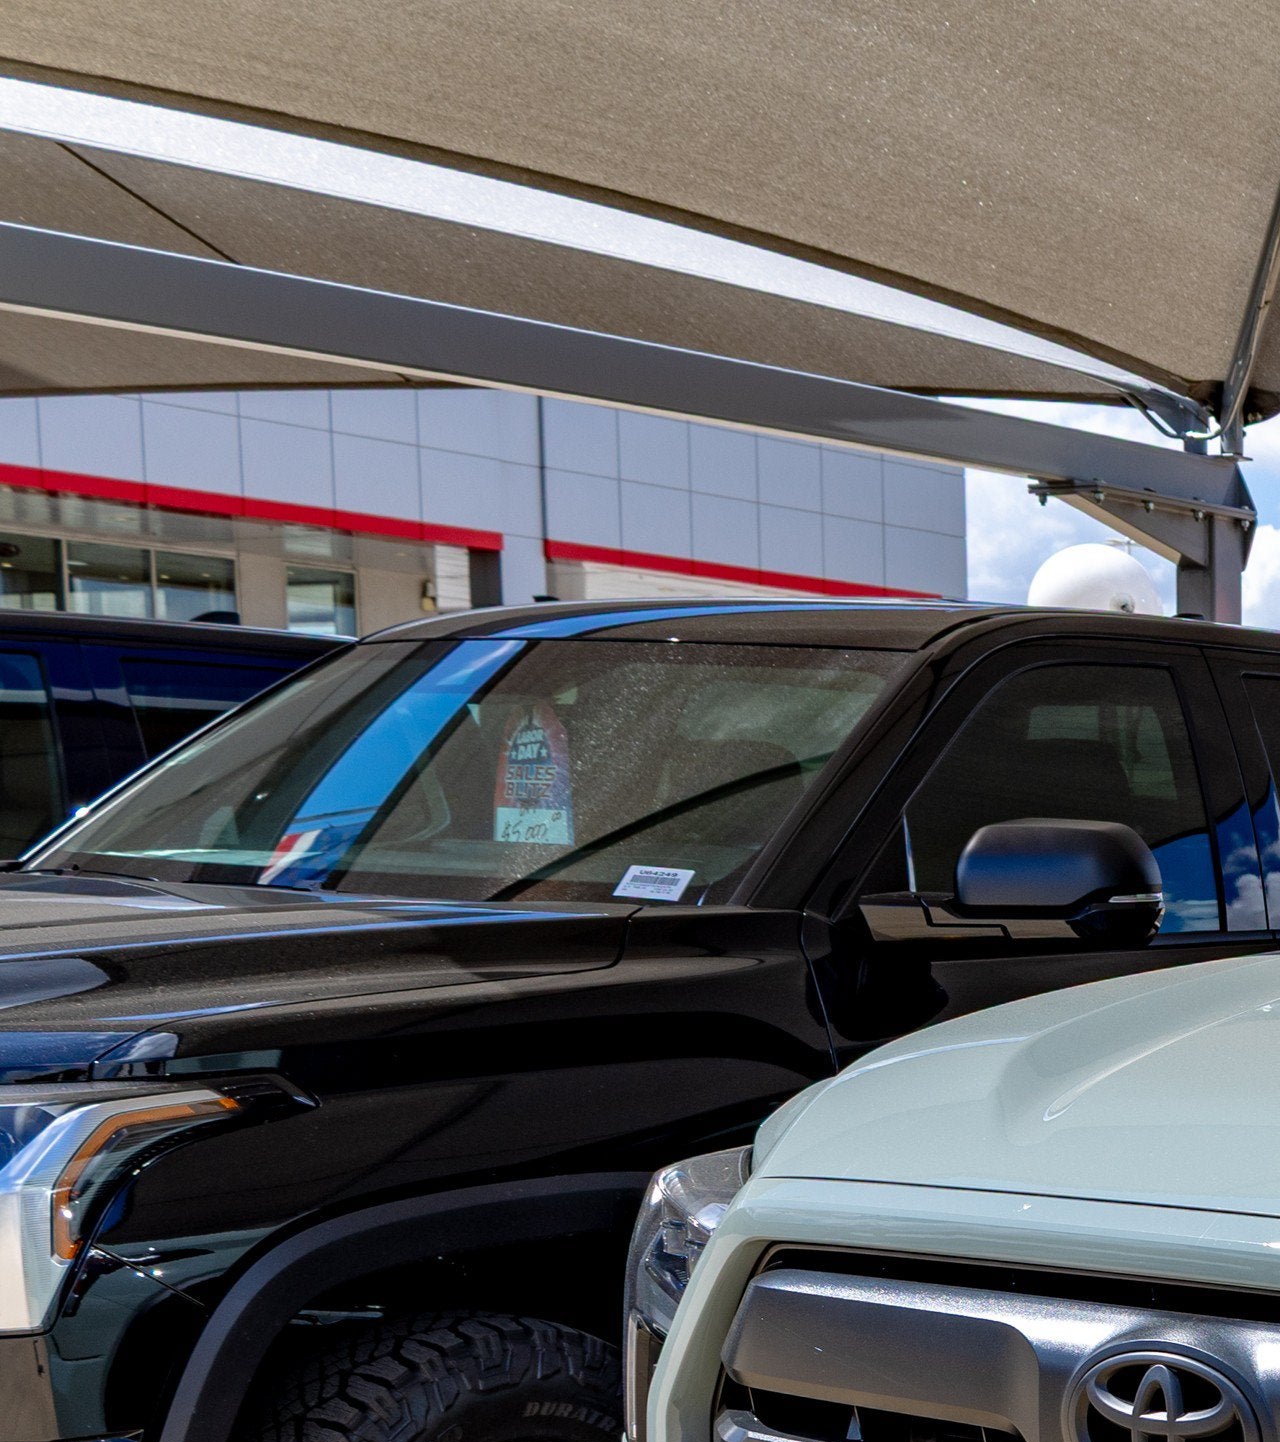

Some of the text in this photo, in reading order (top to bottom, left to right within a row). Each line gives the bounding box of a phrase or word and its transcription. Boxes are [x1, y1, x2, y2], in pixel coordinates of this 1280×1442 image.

[518, 742, 541, 760] DAY
[505, 764, 557, 781] SALES
[504, 780, 553, 798] BLITZ
